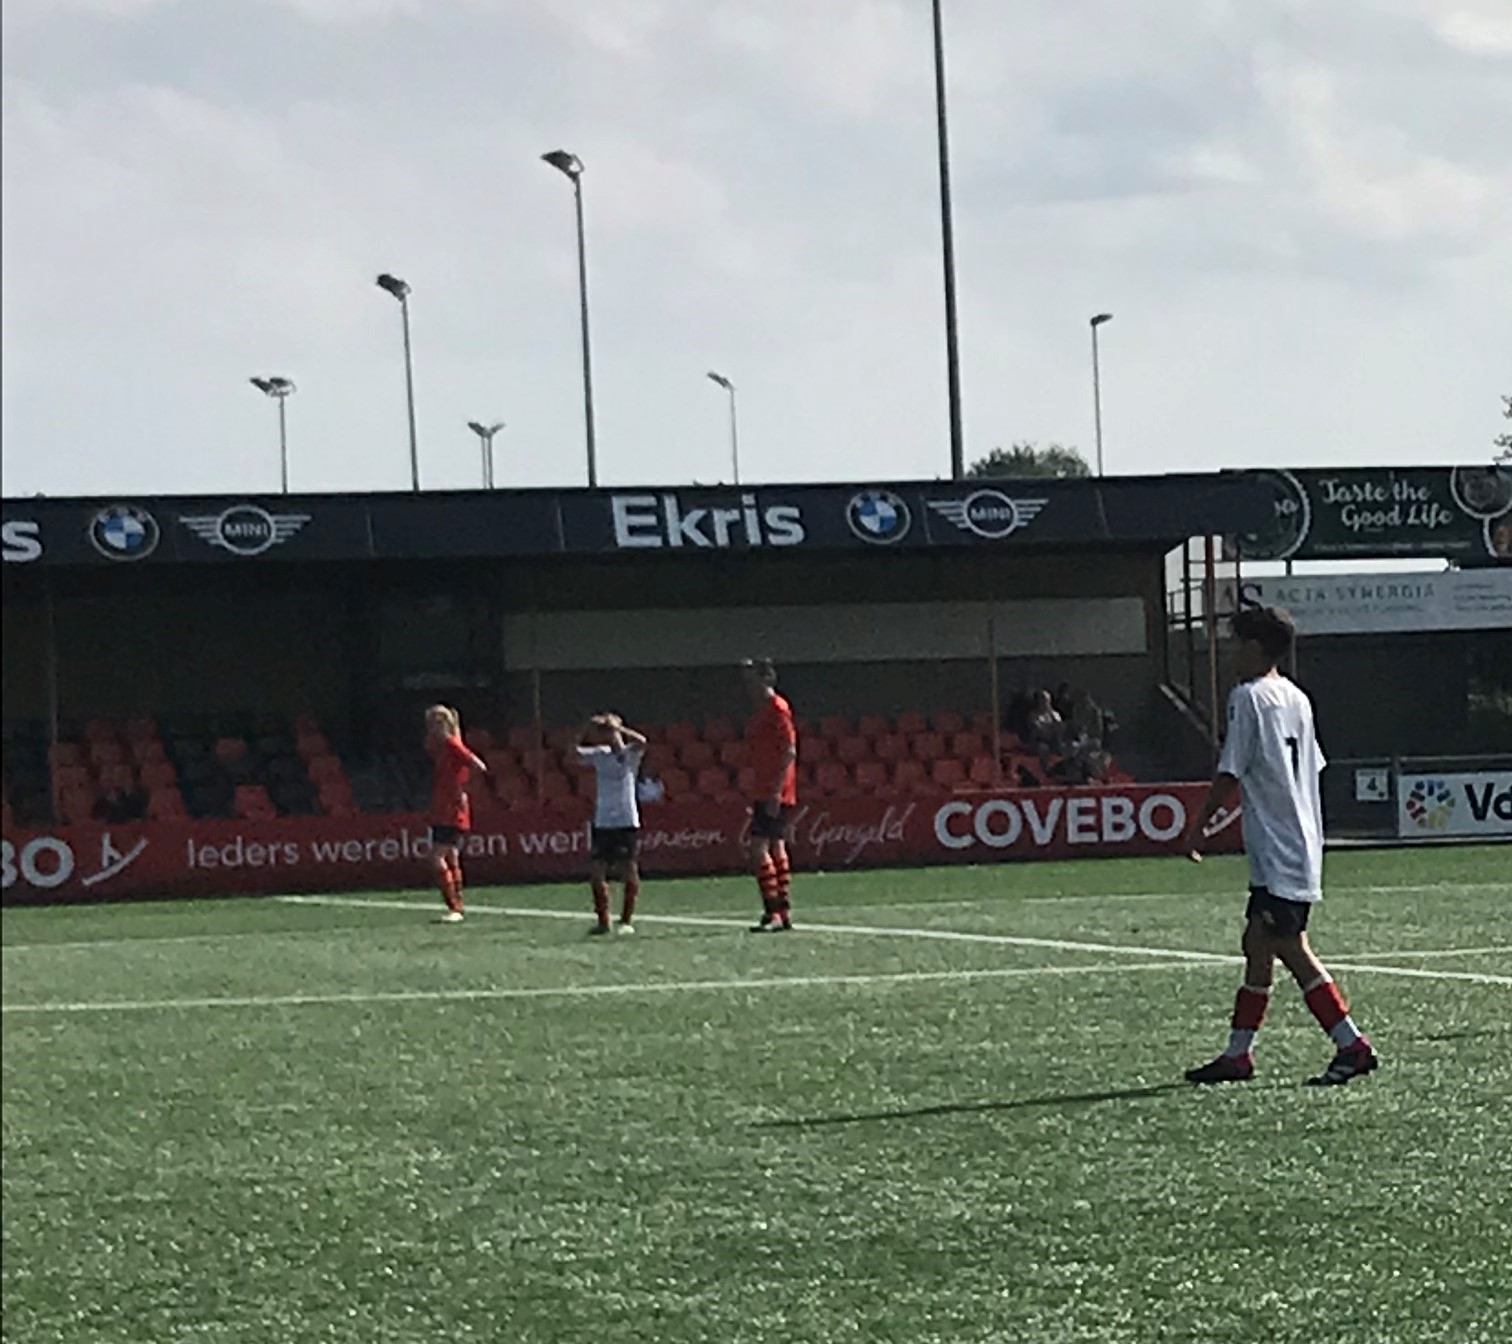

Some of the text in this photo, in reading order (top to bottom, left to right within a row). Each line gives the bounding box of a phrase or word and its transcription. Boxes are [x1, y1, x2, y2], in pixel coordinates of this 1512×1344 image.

[1318, 478, 1433, 504] Taste the
[224, 522, 268, 537] MINI
[611, 493, 807, 548] Ekris
[1341, 503, 1454, 532] Good Life
[934, 794, 1187, 849] COVEBO
[312, 826, 433, 862] wereld
